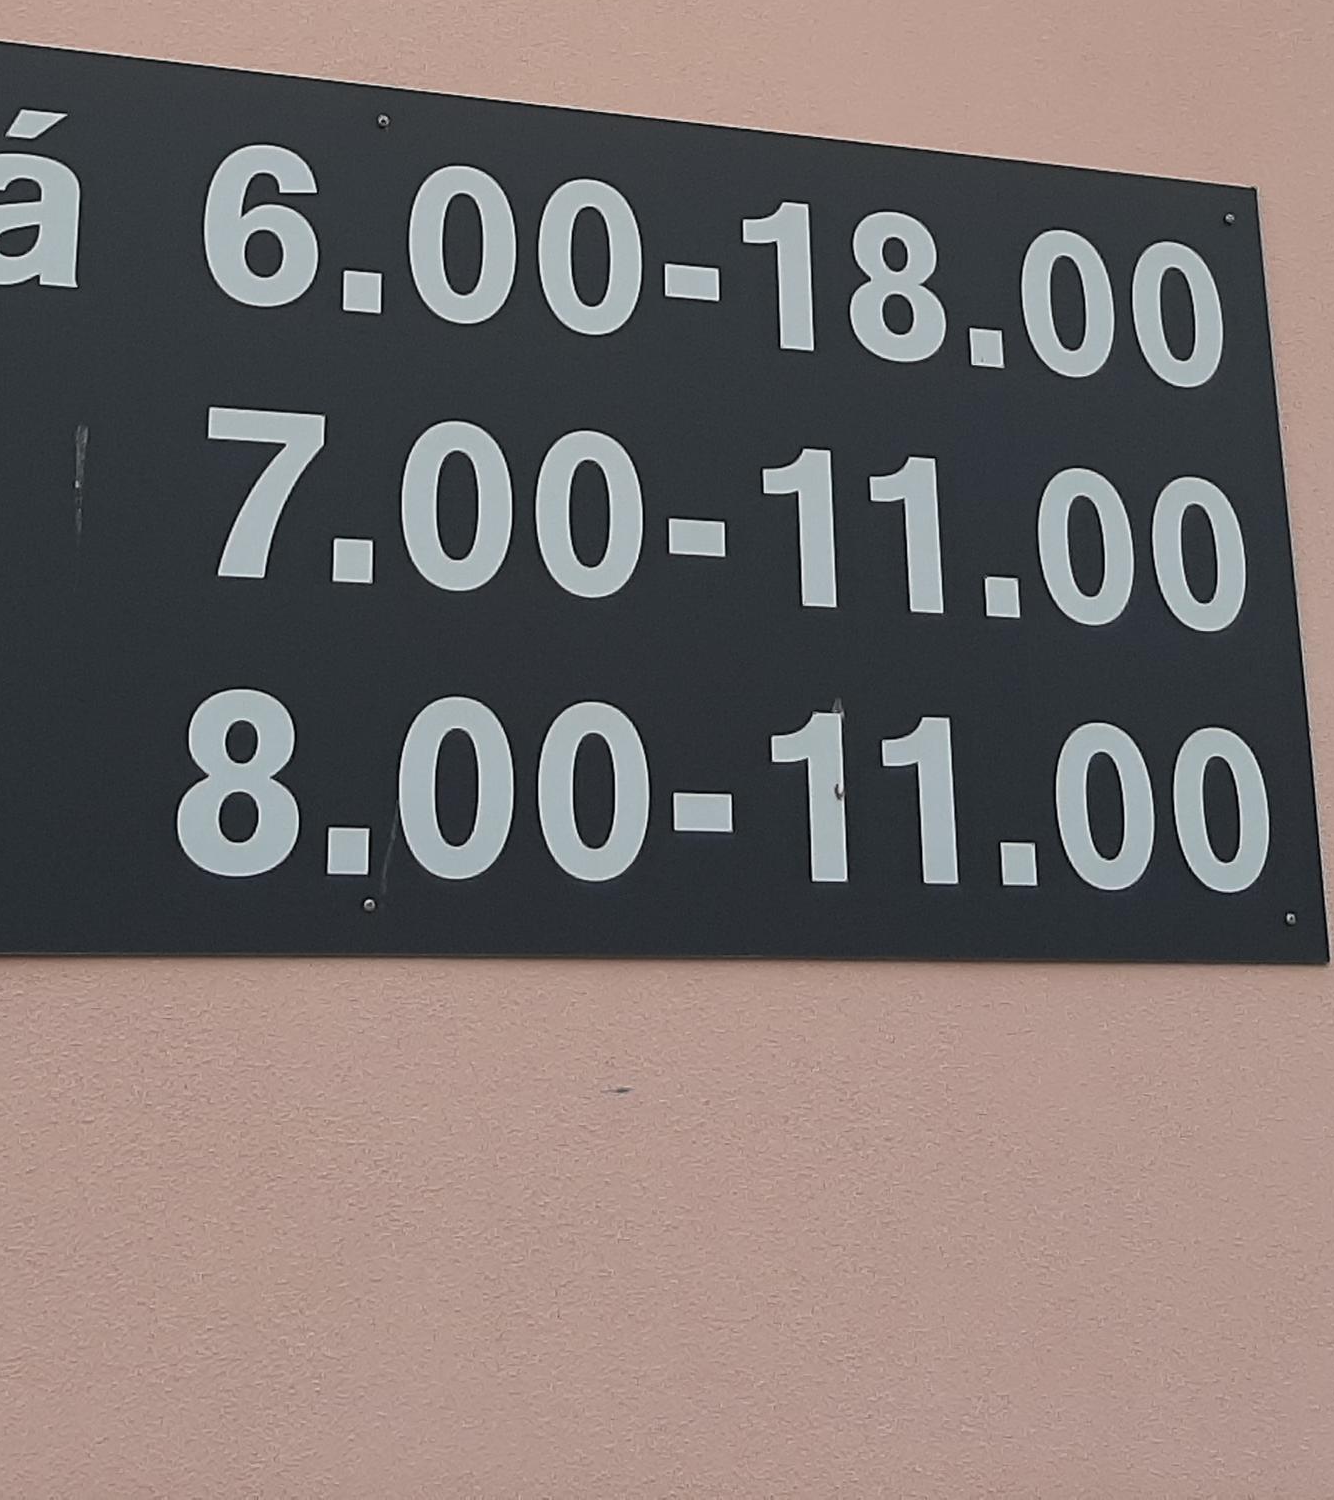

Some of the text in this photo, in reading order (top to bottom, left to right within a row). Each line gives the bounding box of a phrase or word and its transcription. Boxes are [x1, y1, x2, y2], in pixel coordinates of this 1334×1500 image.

[204, 145, 1223, 387] 6.00-18.00
[208, 407, 1246, 631] 7.00-11.00
[178, 690, 1269, 892] 8.00-11.00
